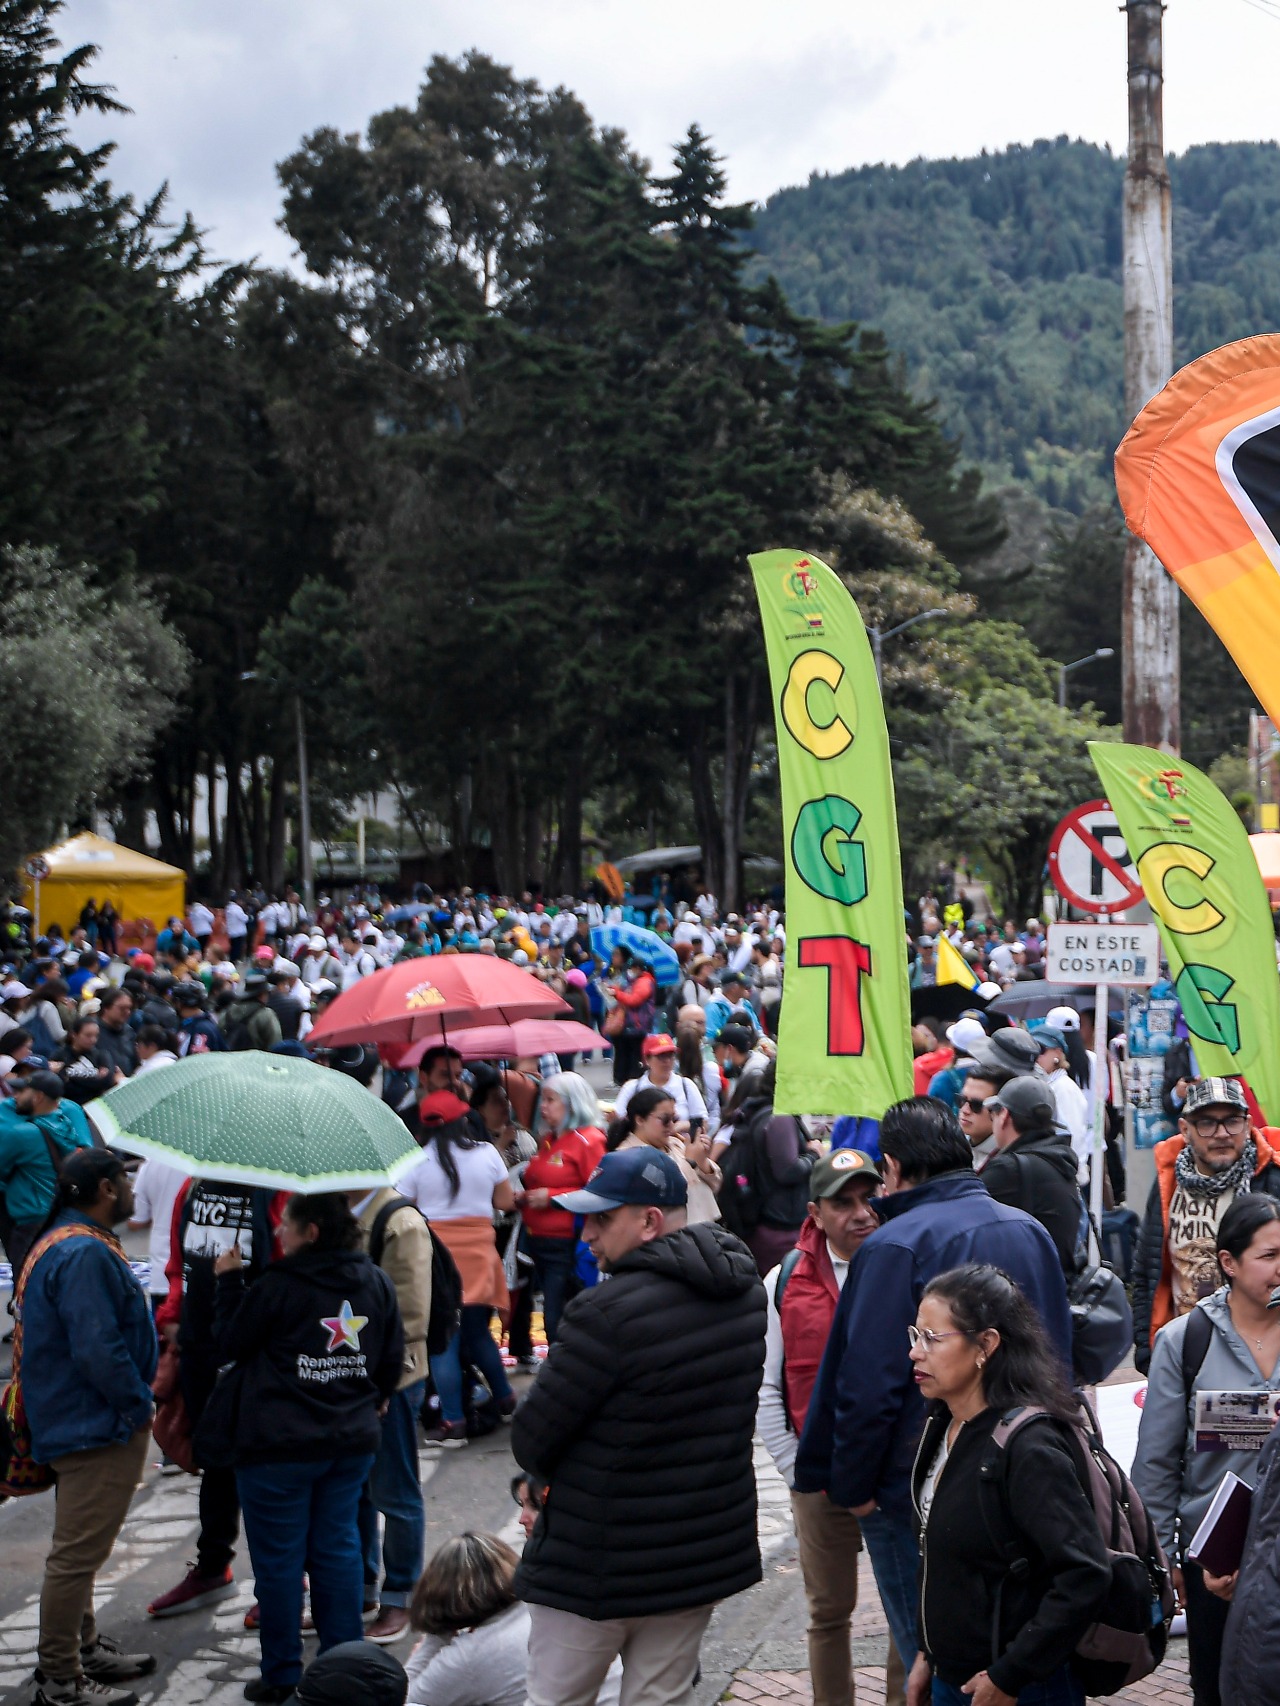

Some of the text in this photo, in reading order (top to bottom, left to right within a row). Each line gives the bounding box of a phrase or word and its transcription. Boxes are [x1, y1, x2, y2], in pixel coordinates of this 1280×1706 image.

[781, 648, 873, 1057] CGT
[1065, 936, 1140, 950] EN ESTE
[1059, 958, 1143, 972] COSTAD
[1169, 1218, 1217, 1244] MAID
